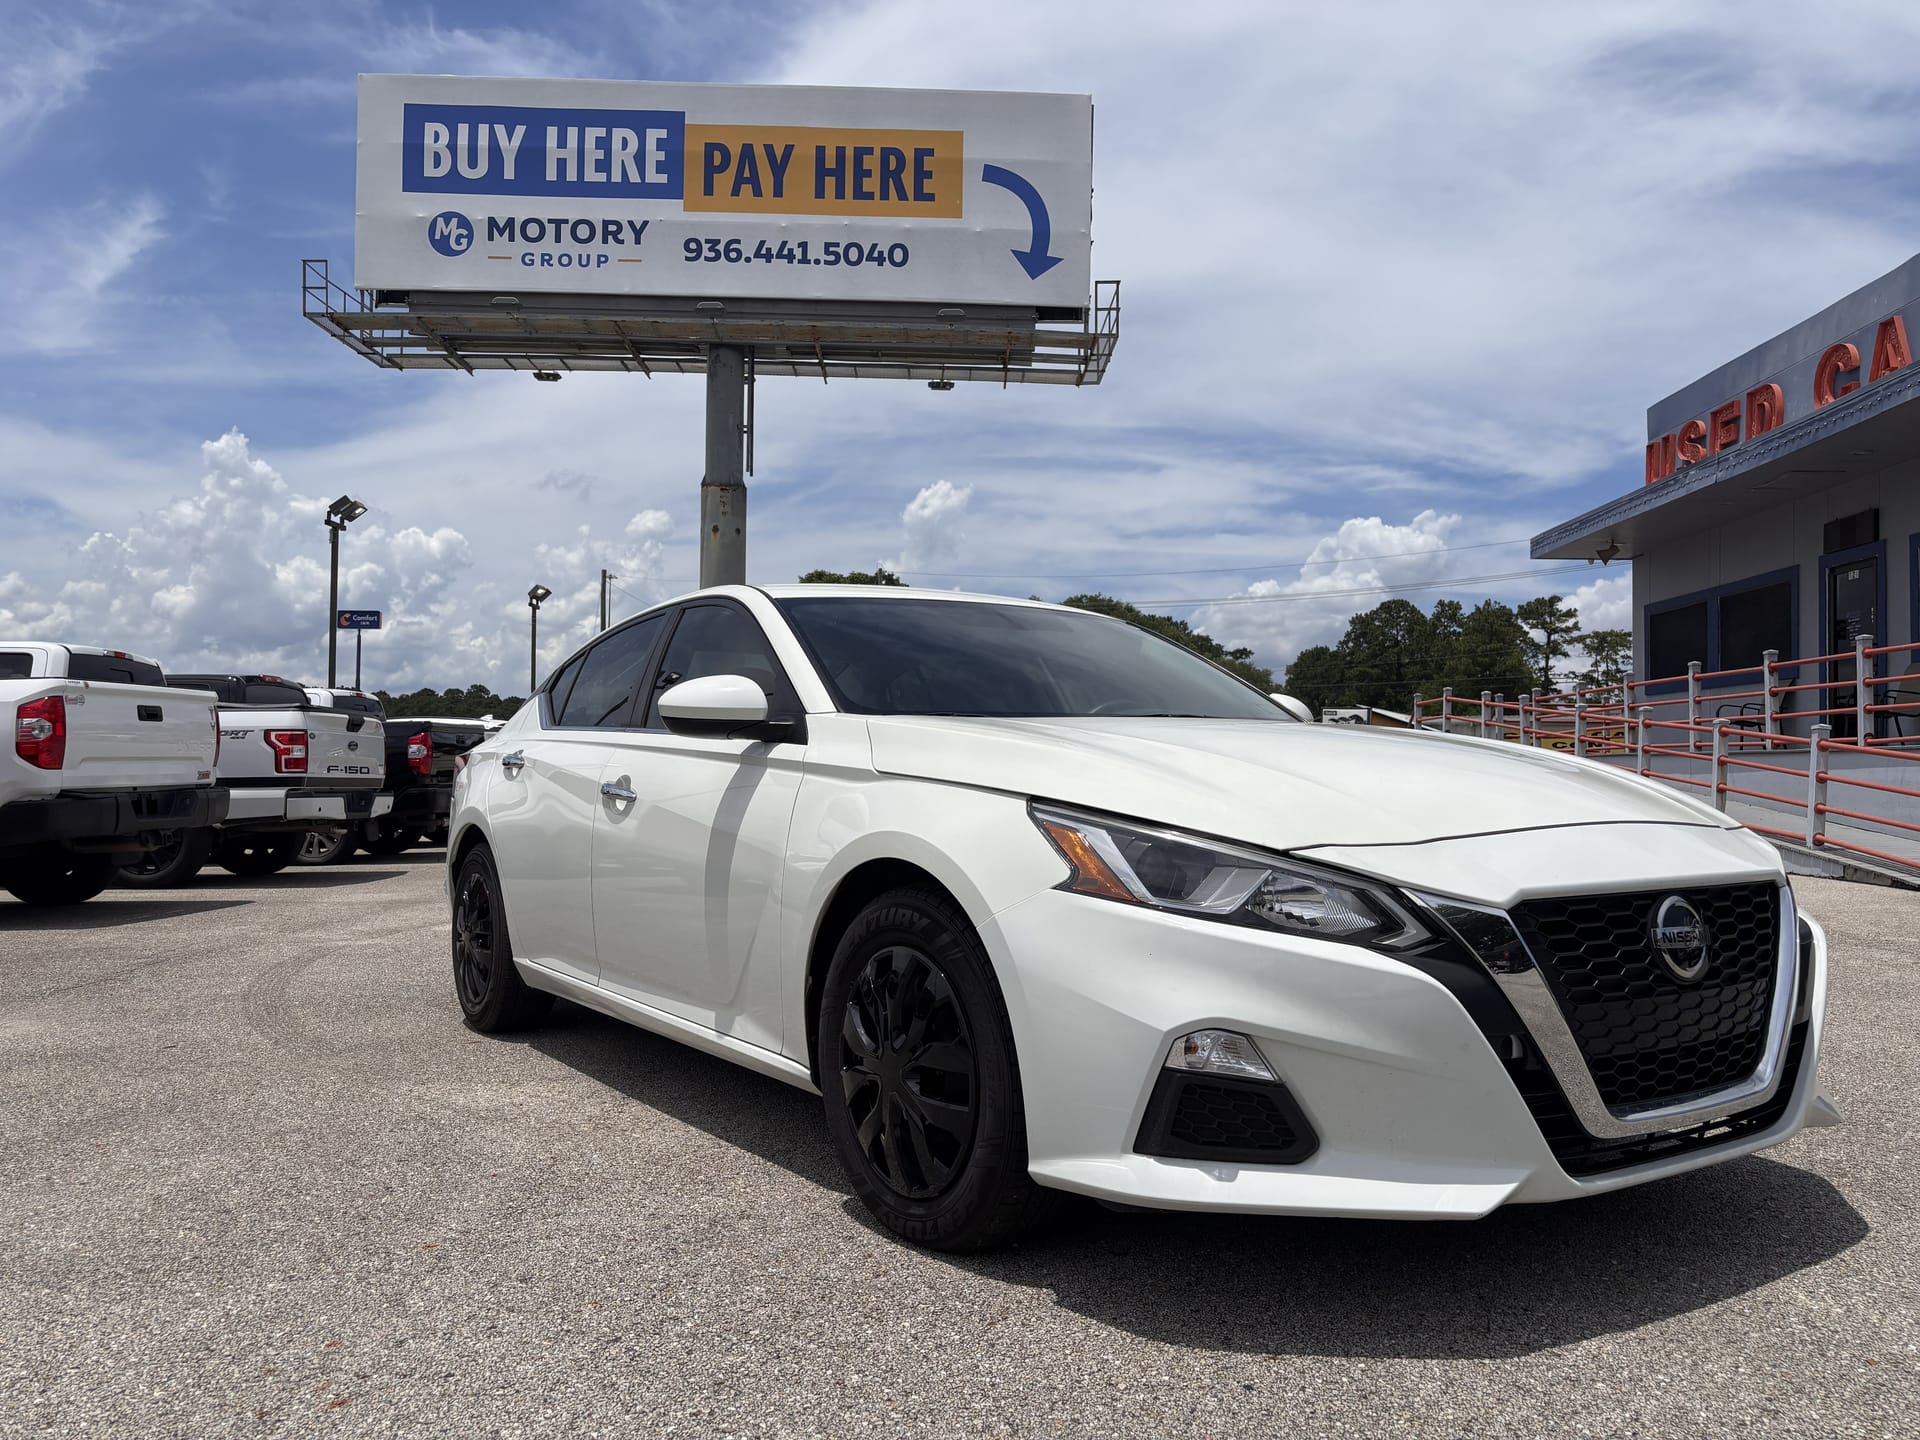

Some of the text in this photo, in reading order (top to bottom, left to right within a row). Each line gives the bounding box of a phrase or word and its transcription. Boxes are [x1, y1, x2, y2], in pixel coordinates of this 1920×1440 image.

[423, 121, 669, 184] BUY HERE
[703, 142, 936, 202] PAY HERE
[487, 216, 650, 245] MOTORY
[520, 252, 609, 268] GROUP
[683, 237, 910, 267] 936.441.5040
[1645, 383, 1785, 486] USED
[327, 765, 370, 775] F-150
[1661, 930, 1703, 945] NISS
